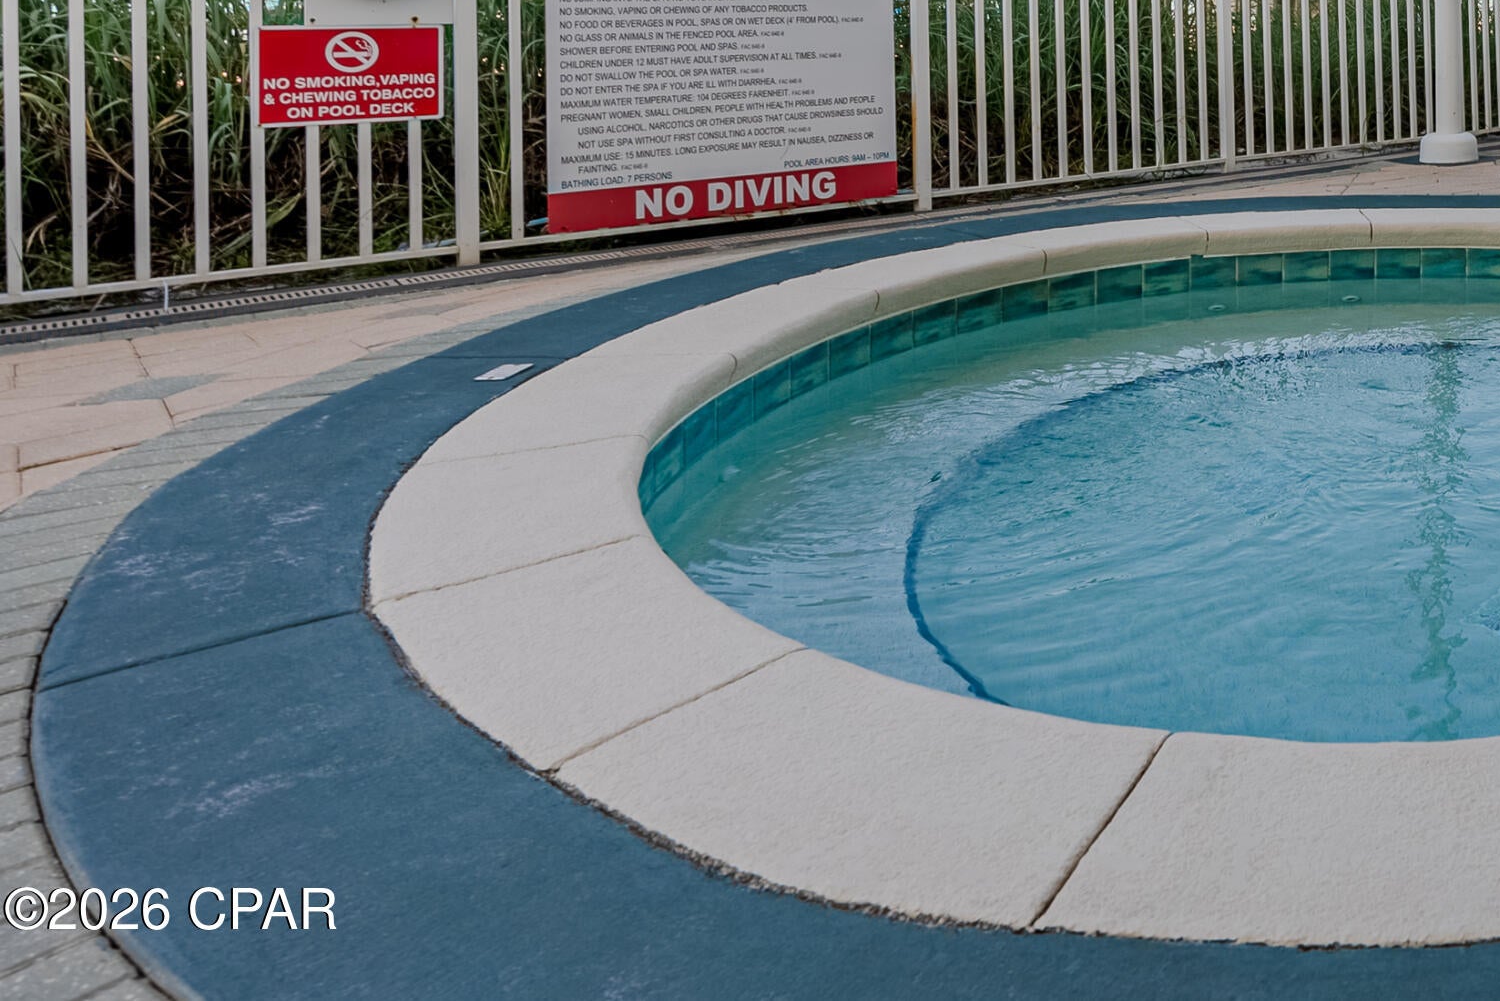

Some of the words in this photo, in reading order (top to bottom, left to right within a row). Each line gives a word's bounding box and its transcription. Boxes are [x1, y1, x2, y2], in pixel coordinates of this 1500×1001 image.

[559, 7, 572, 15] NO
[617, 6, 648, 14] VAPING
[649, 6, 661, 14] OR
[662, 5, 700, 14] CHEWING
[701, 5, 712, 13] OF
[713, 5, 729, 13] ANY
[731, 4, 767, 13] TOBACCO
[559, 20, 572, 29] NO
[573, 19, 599, 28] FOOD
[600, 19, 613, 28] OR
[614, 18, 664, 27] BEVERAGES
[665, 18, 673, 26] IN
[699, 17, 721, 26] SPAS
[721, 17, 733, 25] OR
[734, 17, 746, 25] ON
[747, 16, 763, 25] WET
[765, 16, 785, 24] DECK
[795, 15, 816, 23] FROM
[559, 33, 573, 42] NO
[574, 32, 602, 41] GLASS
[603, 32, 617, 41] OR
[618, 31, 654, 40] ANIMALS
[655, 31, 663, 39] IN
[665, 31, 681, 39] THE
[682, 30, 714, 38] FENCED
[715, 29, 735, 38] POOL
[559, 46, 597, 55] SHOWER
[599, 45, 632, 54] BEFORE
[634, 43, 675, 53] ENTERING
[676, 43, 697, 51] POOL
[699, 42, 716, 50] AND
[559, 59, 603, 69] CHILDREN
[604, 58, 633, 67] UNDER
[636, 57, 644, 66] 12
[646, 56, 668, 65] MUST
[670, 55, 691, 64] HAVE
[692, 55, 717, 64] ADULT
[719, 53, 769, 63] SUPERVISION
[769, 52, 779, 61] AT
[780, 52, 792, 60] ALL
[559, 73, 573, 82] DO
[574, 72, 592, 81] NOT
[594, 70, 636, 81] SWALLOW
[638, 70, 654, 79] THE
[655, 69, 677, 78] POOL
[678, 68, 691, 77] OR
[692, 67, 708, 76] SPA
[263, 77, 290, 90] NO
[559, 86, 573, 95] DO
[574, 85, 592, 95] NOT
[594, 84, 623, 94] ENTER
[624, 83, 640, 92] THE
[642, 82, 659, 91] SPA
[660, 82, 667, 90] IF
[669, 81, 687, 90] YOU
[687, 80, 703, 89] ARE
[705, 79, 716, 88] ILL
[717, 78, 737, 87] WITH
[263, 93, 275, 105] &
[279, 90, 357, 105] CHEWING
[360, 87, 435, 101] TOBACCO
[560, 98, 601, 109] MAXIMUM
[602, 96, 632, 106] WATER
[697, 92, 709, 101] 104
[710, 90, 747, 100] DEGREES
[286, 106, 314, 119] ON
[318, 104, 365, 117] POOL
[369, 102, 415, 115] DECK
[783, 158, 803, 169] POOL
[804, 157, 823, 167] AREA
[851, 153, 866, 163] 9AM
[872, 151, 889, 161] 10PM
[561, 177, 599, 189] BATHING
[627, 174, 632, 183] 7
[633, 170, 672, 182] PERSONS
[635, 185, 694, 220] NO
[707, 171, 837, 212] DIVING
